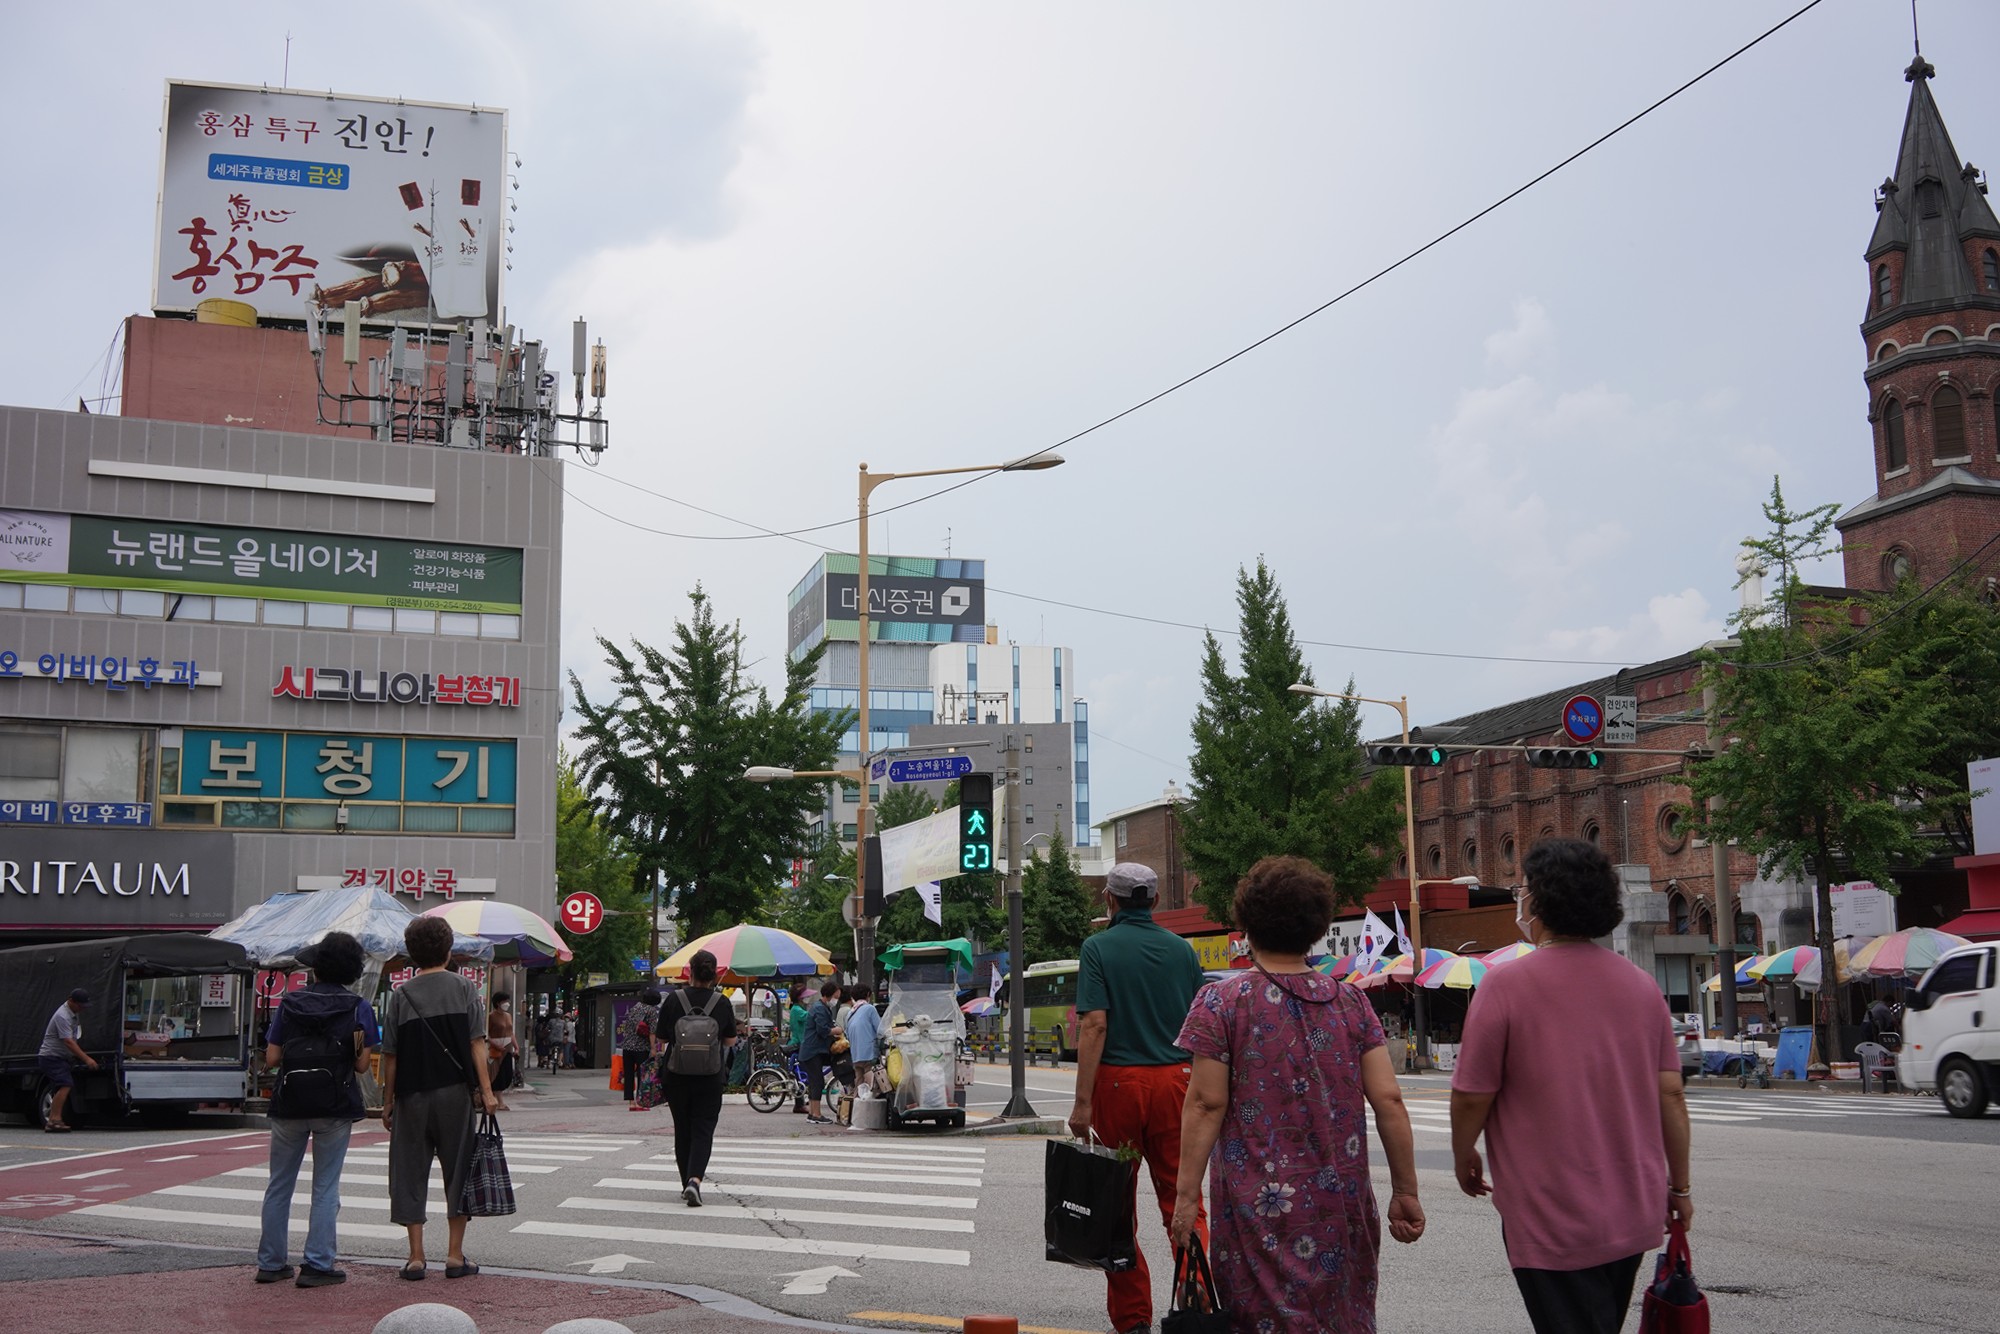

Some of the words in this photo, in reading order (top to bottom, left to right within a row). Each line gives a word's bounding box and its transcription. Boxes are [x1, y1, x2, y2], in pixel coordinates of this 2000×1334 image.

[198, 111, 254, 139] 홍삼
[264, 116, 321, 145] 특구
[213, 162, 301, 183] 세계주류품평회
[307, 165, 344, 186] 금상
[171, 216, 320, 297] 홍삼주
[7, 520, 24, 531] NEW
[27, 520, 48, 535] LAND
[15, 535, 53, 547] NATURE
[107, 529, 378, 578] 뉴랜드올네이처
[841, 587, 933, 616] 대신증권
[37, 653, 200, 691] 이비인후과
[1607, 700, 1635, 710] 견인지역
[1570, 715, 1596, 723] 주차금지
[891, 768, 900, 776] 21
[907, 759, 953, 772] 노송여울1길
[960, 763, 970, 772] 25
[0, 861, 190, 896] RITAUM
[341, 868, 458, 899] 경기약국
[566, 898, 595, 930] 약
[1062, 1200, 1092, 1217] renoma
